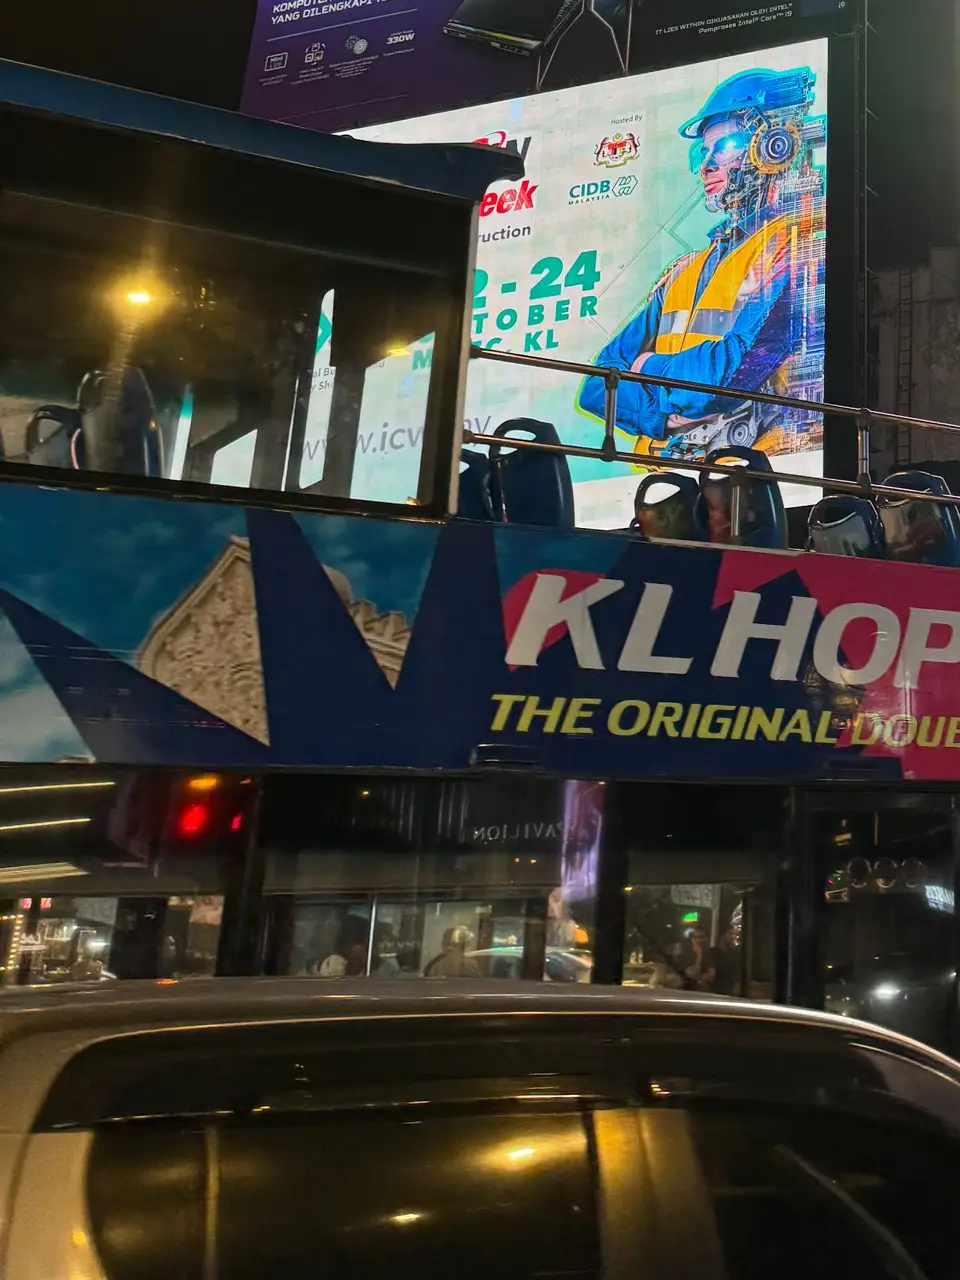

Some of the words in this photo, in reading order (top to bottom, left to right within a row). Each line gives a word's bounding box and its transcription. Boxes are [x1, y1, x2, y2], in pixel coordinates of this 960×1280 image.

[838, 1, 846, 9] i9
[271, 13, 300, 25] YANG
[664, 24, 679, 33] LIES
[679, 21, 705, 31] WITHIN
[698, 22, 737, 34] Pemproses
[386, 32, 416, 45] 330W
[611, 115, 633, 125] Hosted
[634, 115, 643, 123] By
[479, 180, 539, 217] eek
[569, 179, 611, 199] CIDB
[568, 195, 610, 206] MALAYSIA
[477, 225, 532, 244] ruction
[529, 250, 601, 300] 24
[473, 295, 599, 335] TOBER
[524, 329, 559, 353] KL
[504, 572, 694, 676] KL
[490, 693, 602, 735] THE
[607, 699, 839, 745] ORIGINAL
